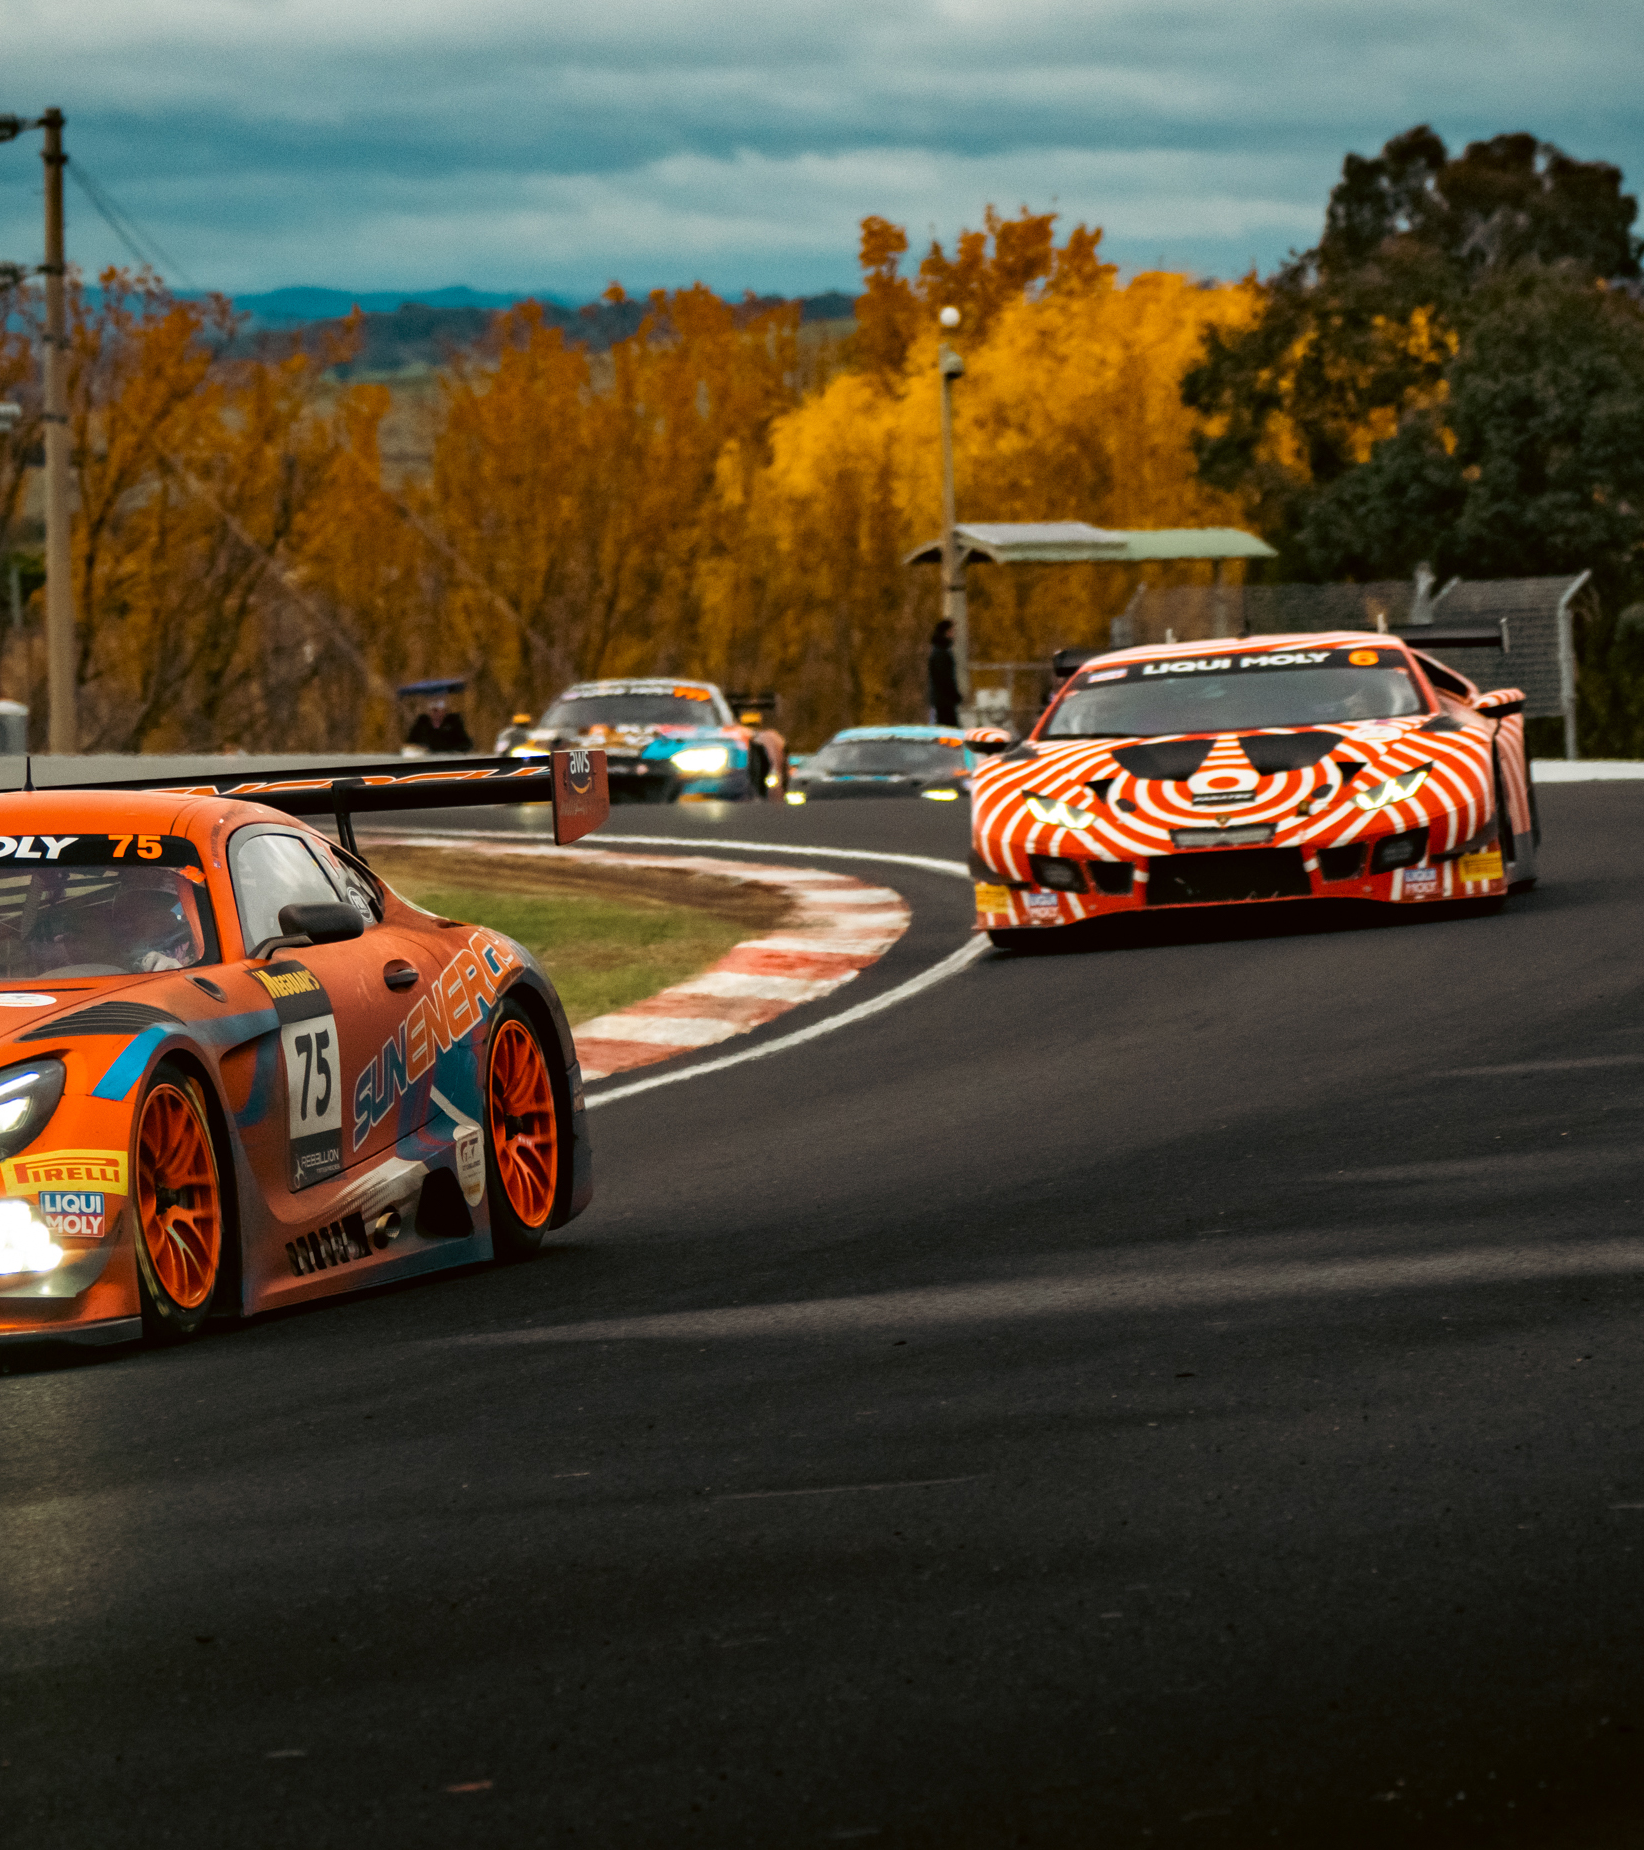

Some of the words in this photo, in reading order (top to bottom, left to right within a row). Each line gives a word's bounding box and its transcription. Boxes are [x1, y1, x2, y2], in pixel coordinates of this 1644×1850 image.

[1142, 658, 1231, 675] LIQUI
[1240, 652, 1330, 668] MOLY
[1348, 650, 1379, 666] 6
[569, 750, 590, 774] aws
[107, 834, 163, 859] 75
[294, 1028, 332, 1121] 75
[301, 1148, 340, 1168] REBELLION
[13, 1157, 120, 1184] PIRELLI
[44, 1194, 101, 1214] LIQUI
[45, 1215, 103, 1235] MOLY
